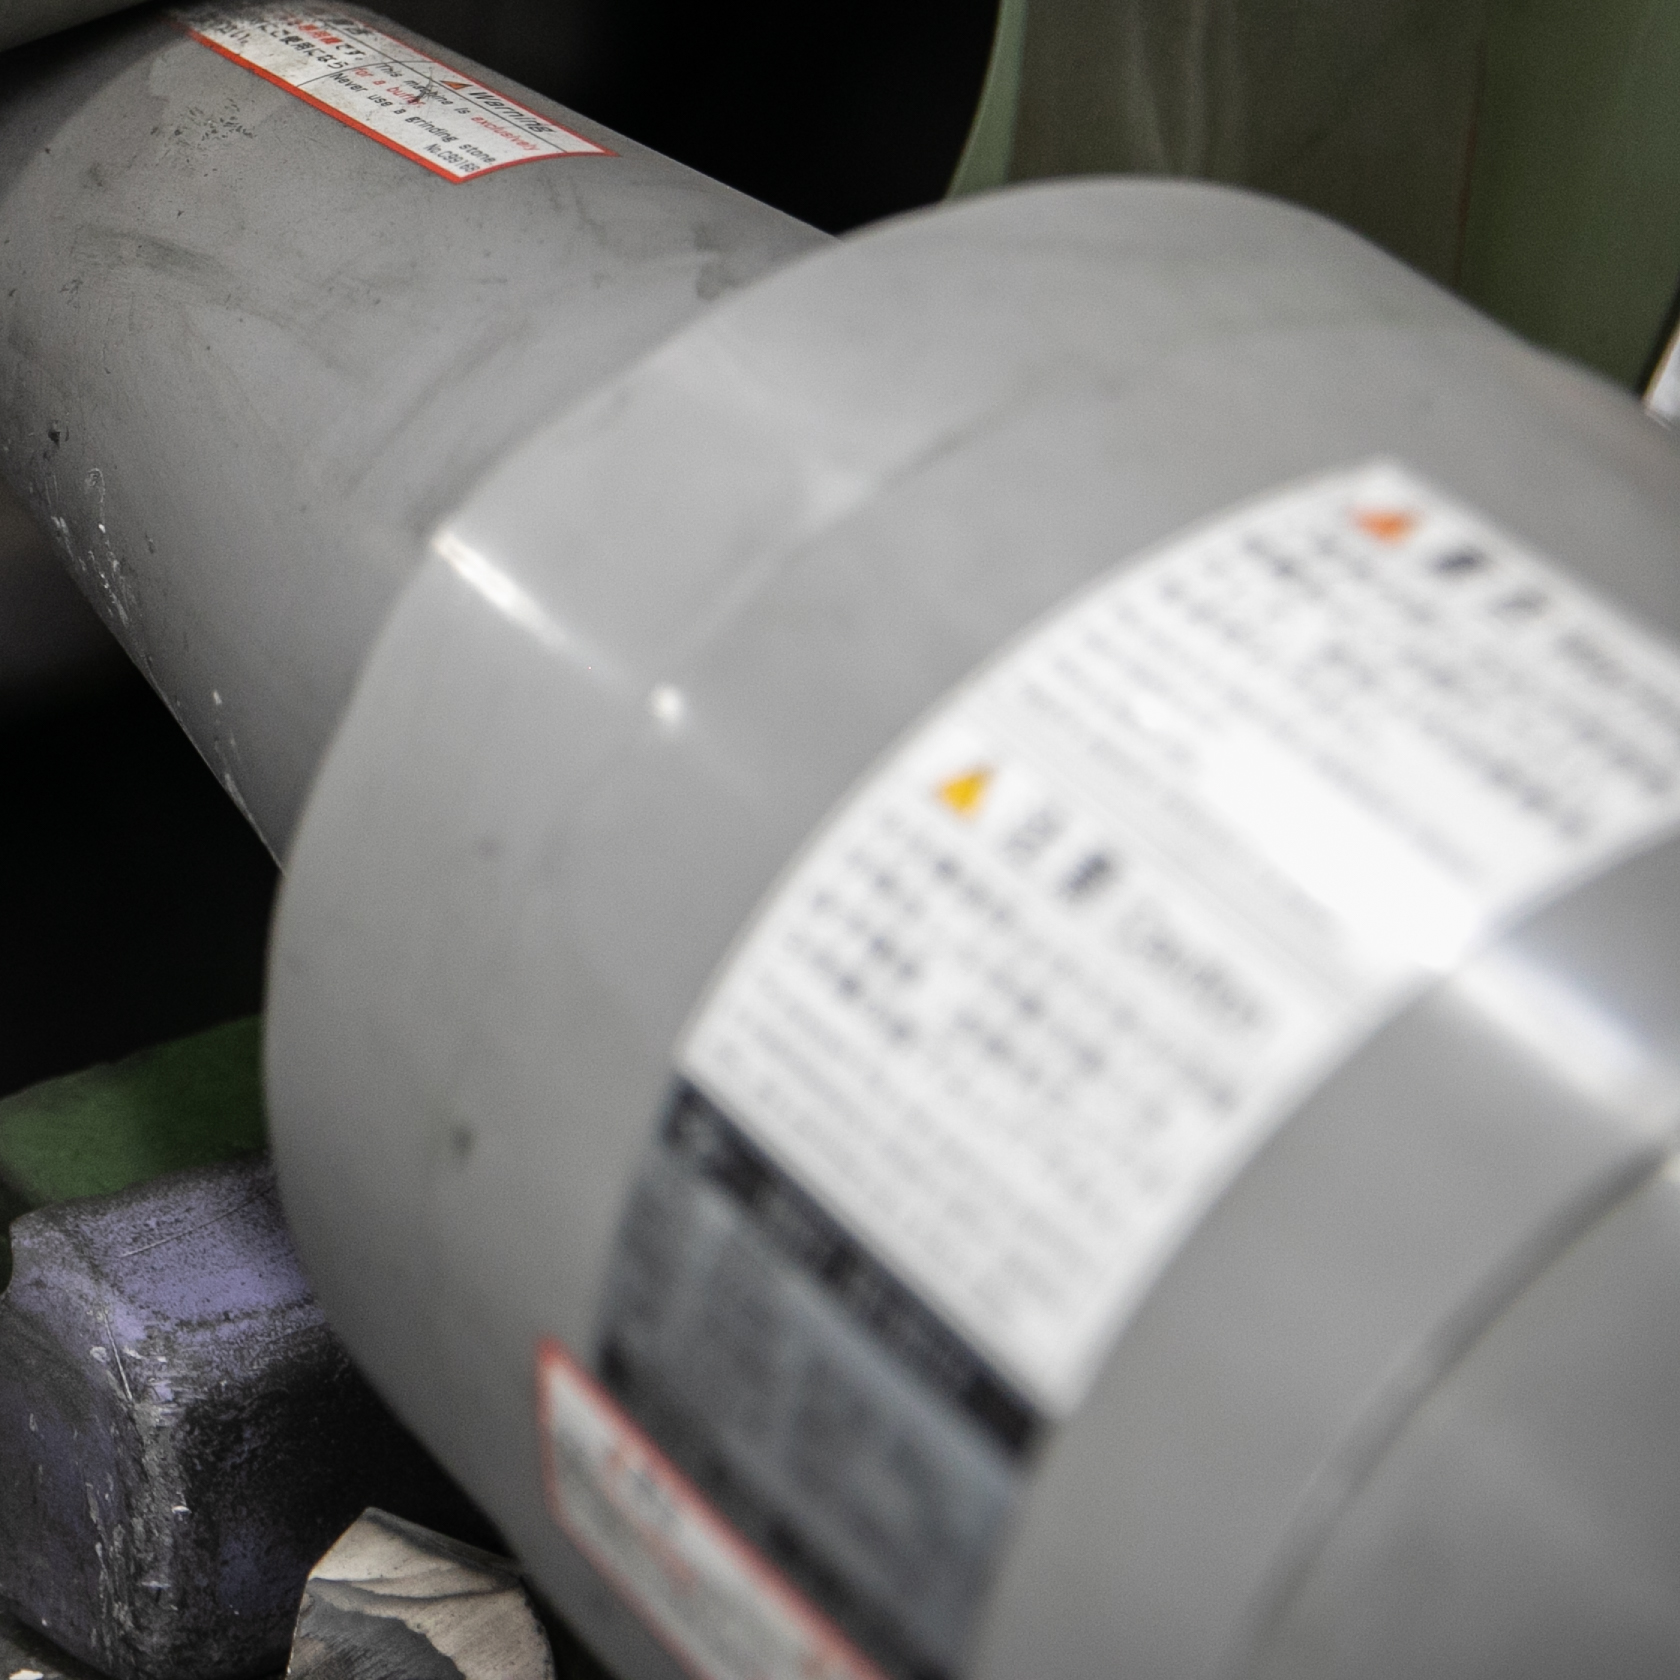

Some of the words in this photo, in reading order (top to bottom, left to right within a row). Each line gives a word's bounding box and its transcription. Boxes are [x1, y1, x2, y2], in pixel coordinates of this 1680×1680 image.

[354, 67, 375, 78] for
[330, 72, 368, 93] Never
[367, 94, 393, 107] use
[405, 116, 460, 143] grinding
[375, 63, 402, 78] This
[454, 107, 471, 115] is
[471, 116, 540, 151] exclusively
[468, 91, 556, 133] Warning
